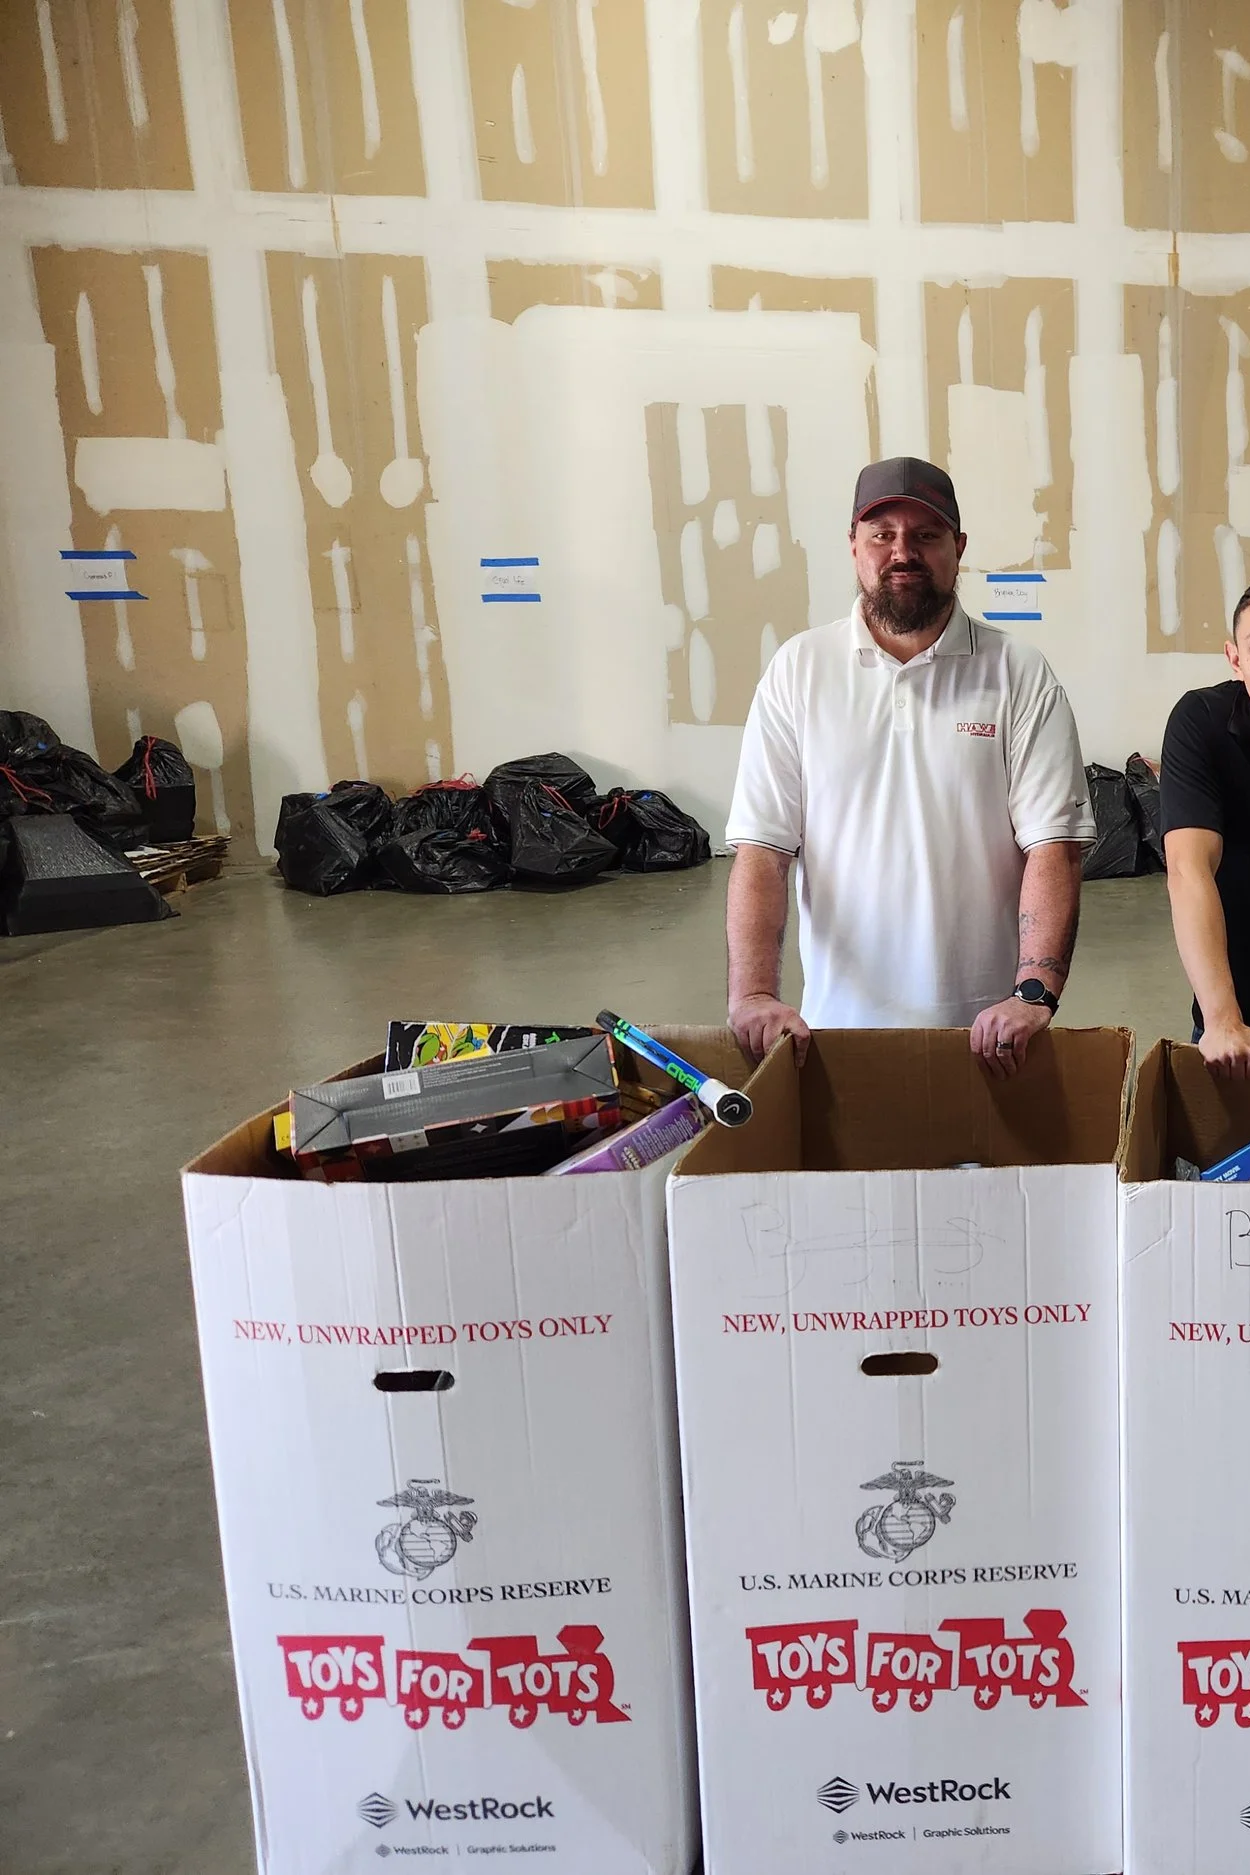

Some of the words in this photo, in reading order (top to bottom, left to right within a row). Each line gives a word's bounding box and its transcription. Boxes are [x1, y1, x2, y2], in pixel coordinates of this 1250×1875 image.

[665, 1062, 703, 1094] HEAD
[235, 1321, 291, 1344] NEW,
[299, 1325, 457, 1344] UNWRAPPED
[463, 1320, 532, 1341] TOYS
[539, 1315, 611, 1337] ONLY
[724, 1314, 785, 1334] NEW,
[793, 1310, 948, 1331] UNWRAPPED
[954, 1307, 1017, 1326] TOYS
[1024, 1304, 1090, 1324] ONLY
[1170, 1323, 1230, 1345] NEW,
[741, 1575, 781, 1590] U.S.
[789, 1573, 882, 1588] MARINE
[889, 1569, 966, 1586] CORPS
[975, 1564, 1077, 1582] RESERVE
[269, 1583, 307, 1599] U.S.
[315, 1587, 406, 1604] MARINE
[412, 1587, 493, 1604] CORPS
[501, 1578, 611, 1600] RESERVE
[1176, 1589, 1214, 1603] U.S.
[756, 1632, 849, 1680] TOYS
[870, 1641, 943, 1684] FOR
[965, 1644, 1061, 1687] TOTS
[288, 1645, 379, 1692] TOYS
[400, 1659, 473, 1703] FOR
[496, 1661, 599, 1703] TOTS
[867, 1778, 1010, 1804] WestRock
[406, 1796, 554, 1820] WestRock
[851, 1829, 905, 1841] WestRock
[923, 1827, 962, 1840] Graphic
[964, 1825, 1010, 1837] Solutions
[394, 1844, 449, 1856] WestRock
[467, 1844, 507, 1857] Graphic
[509, 1843, 556, 1854] Solutions
